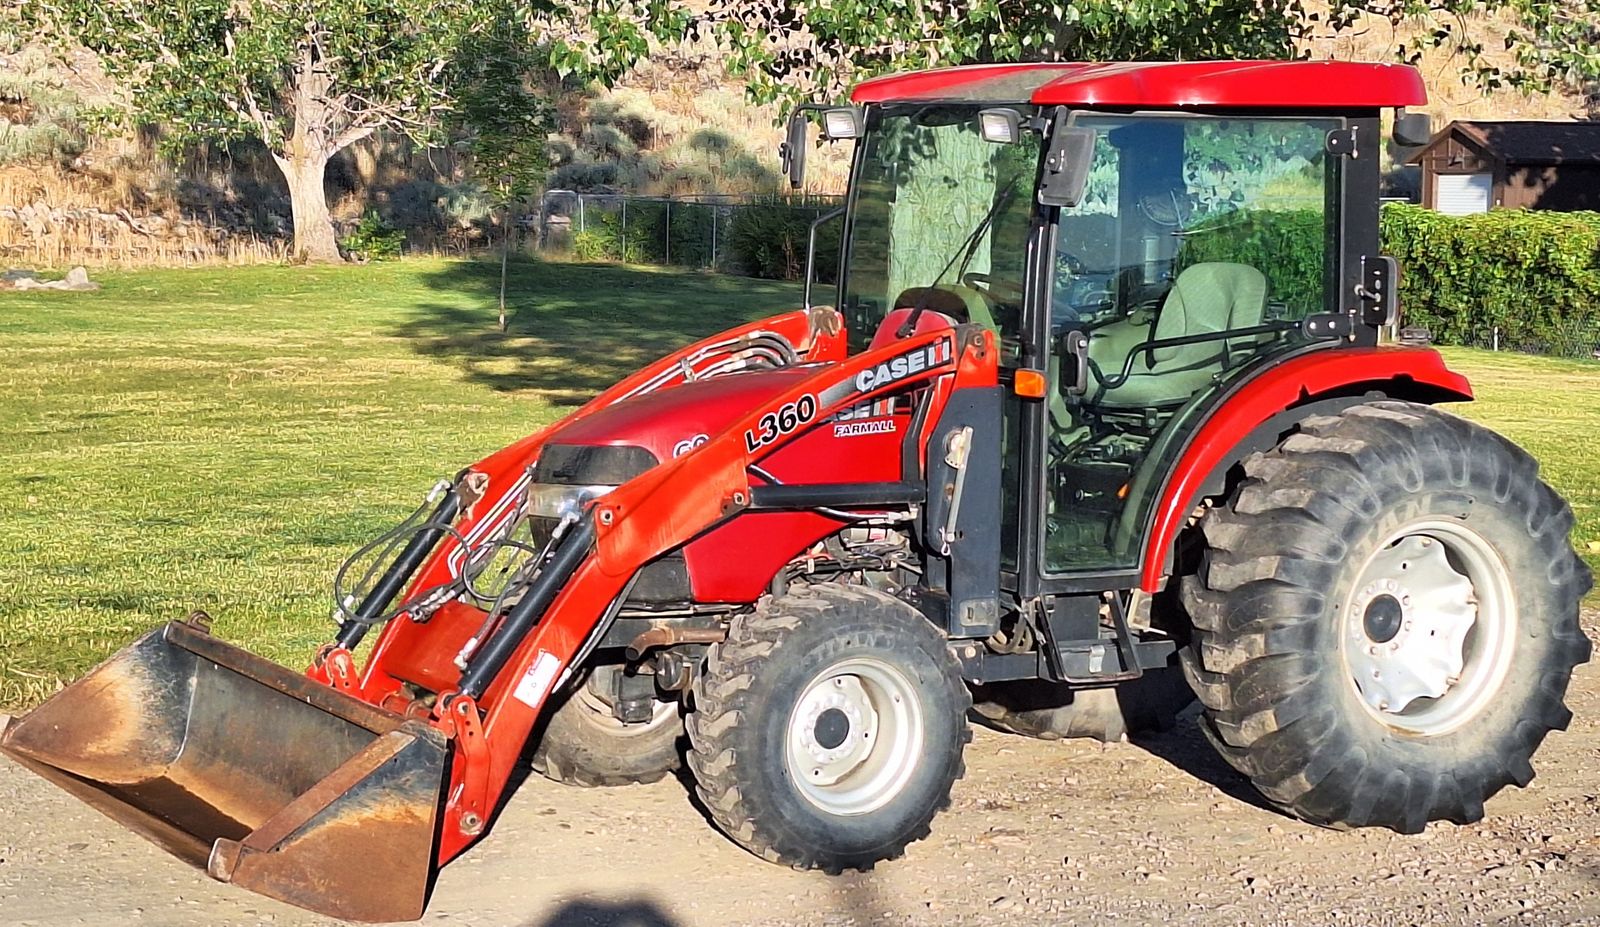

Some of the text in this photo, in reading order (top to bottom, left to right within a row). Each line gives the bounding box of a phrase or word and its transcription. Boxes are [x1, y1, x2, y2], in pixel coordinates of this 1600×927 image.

[856, 350, 925, 391] CASE
[745, 393, 816, 453] L360
[834, 420, 896, 437] FARMALL
